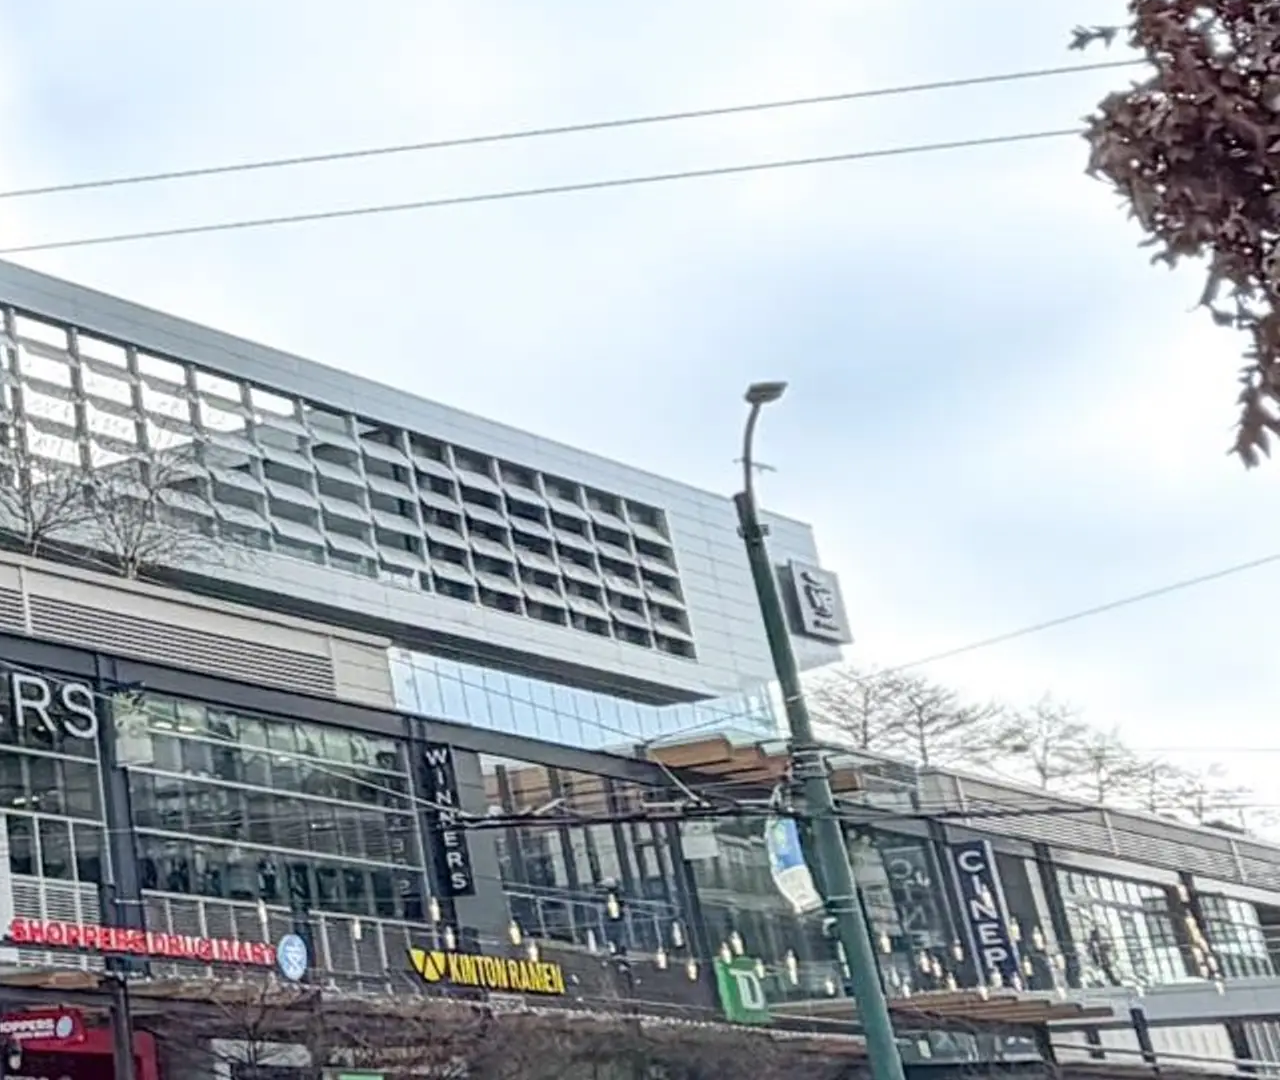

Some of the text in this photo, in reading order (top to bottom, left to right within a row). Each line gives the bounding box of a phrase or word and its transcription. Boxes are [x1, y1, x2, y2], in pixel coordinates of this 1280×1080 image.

[426, 748, 467, 889] WINNERS
[10, 918, 278, 966] SHOPPERS DRUG MART
[448, 952, 566, 994] KINTON RAMEN
